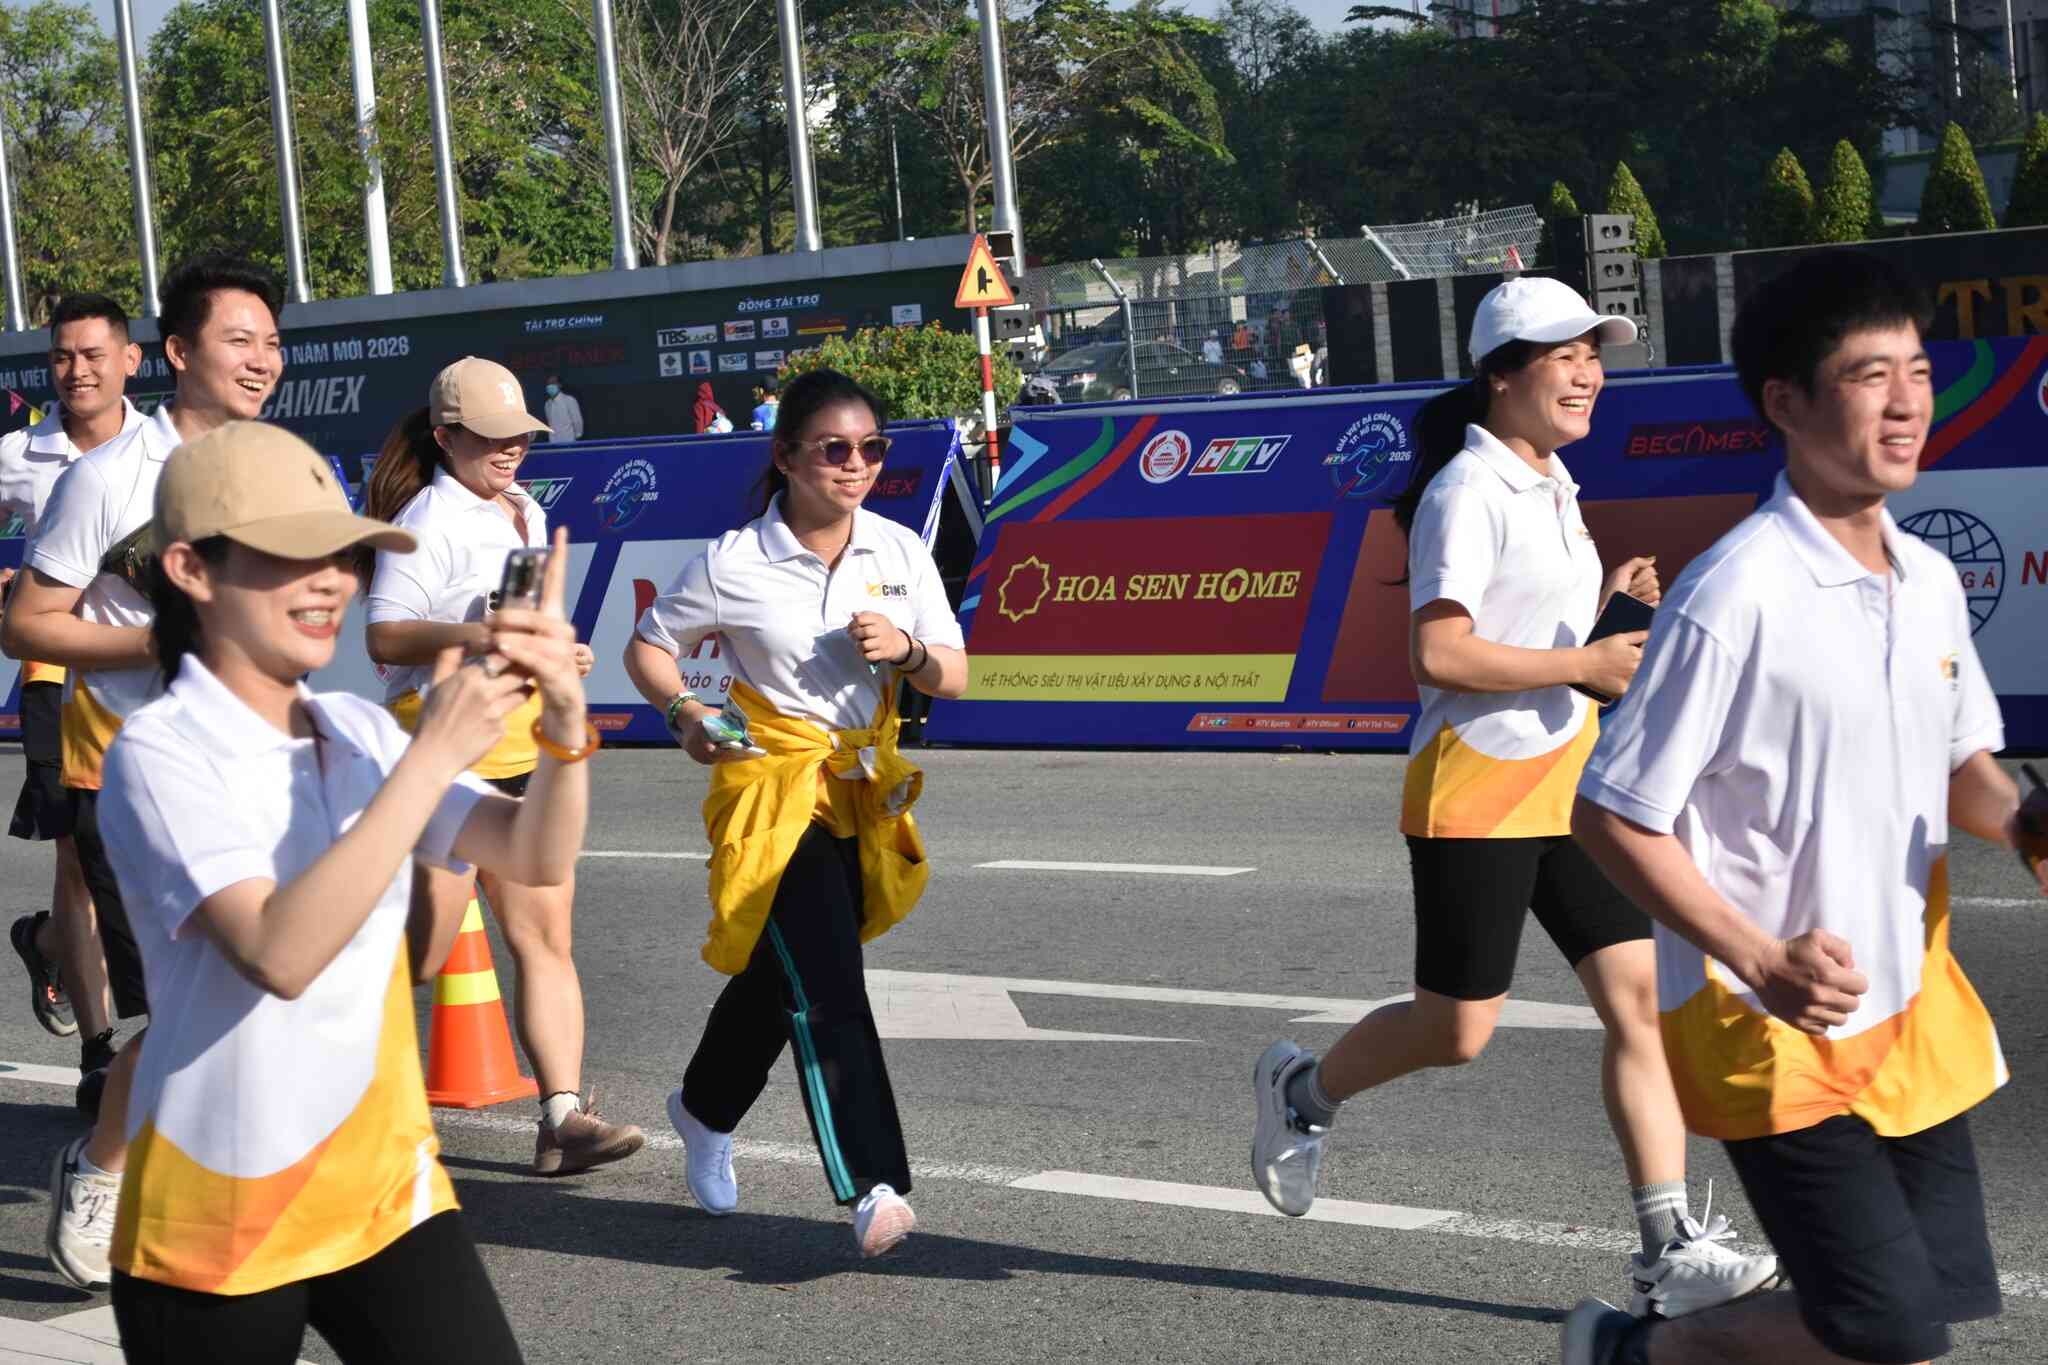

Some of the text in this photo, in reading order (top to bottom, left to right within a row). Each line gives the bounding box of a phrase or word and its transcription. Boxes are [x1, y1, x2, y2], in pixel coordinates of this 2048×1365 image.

[367, 336, 410, 359] 2026
[1198, 442, 1282, 469] HTV
[1388, 451, 1412, 462] 2026
[1053, 568, 1301, 603] HOA SEN HOME
[999, 669, 1039, 688] THỐNG
[1040, 672, 1064, 688] SIÊU
[1066, 674, 1083, 690] THỊ
[1085, 672, 1107, 691] VẬT
[1107, 672, 1130, 691] LIỆU
[1131, 672, 1153, 688] XÂY
[1154, 673, 1192, 691] DỰNG
[1193, 674, 1201, 688] &
[1203, 674, 1228, 691] NỘI
[1229, 669, 1262, 688] THẤT
